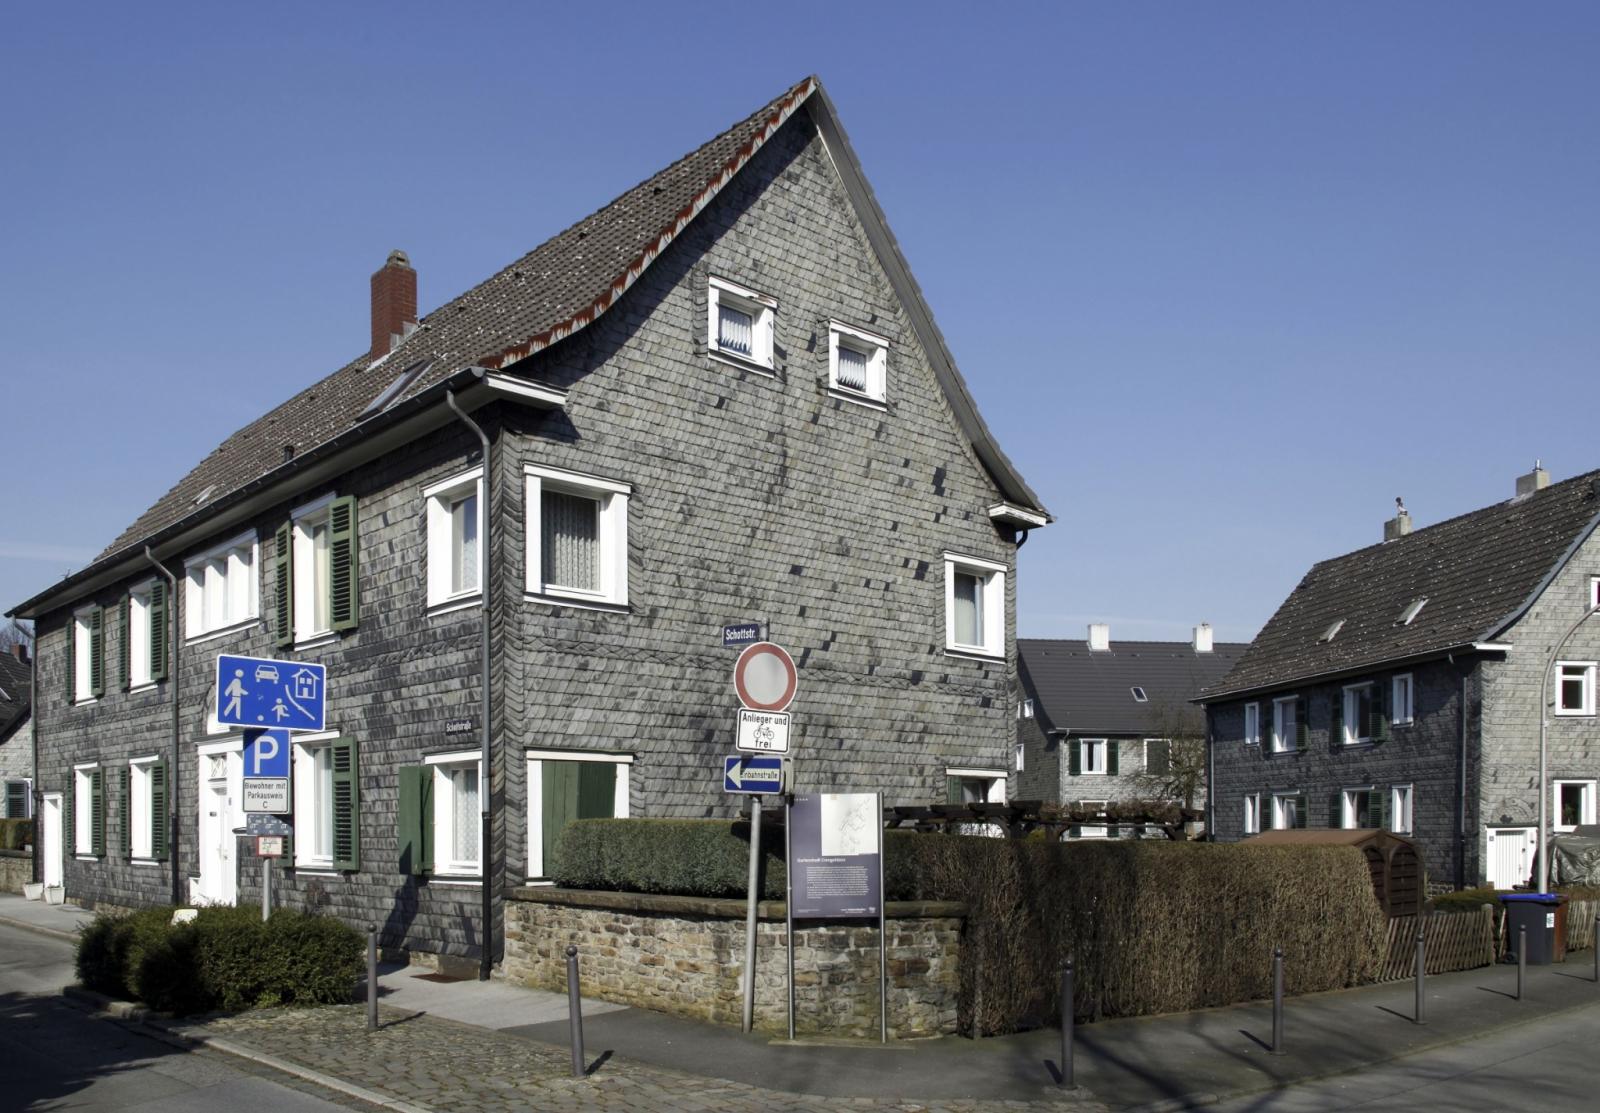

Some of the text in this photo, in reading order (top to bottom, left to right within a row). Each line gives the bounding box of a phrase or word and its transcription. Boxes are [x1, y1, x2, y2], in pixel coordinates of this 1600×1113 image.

[742, 713, 787, 726] Anlieger und
[755, 739, 772, 749] frei
[253, 736, 279, 774] P
[244, 782, 286, 790] Bewohner mit
[247, 791, 283, 799] Parkausweis
[262, 800, 269, 809] C
